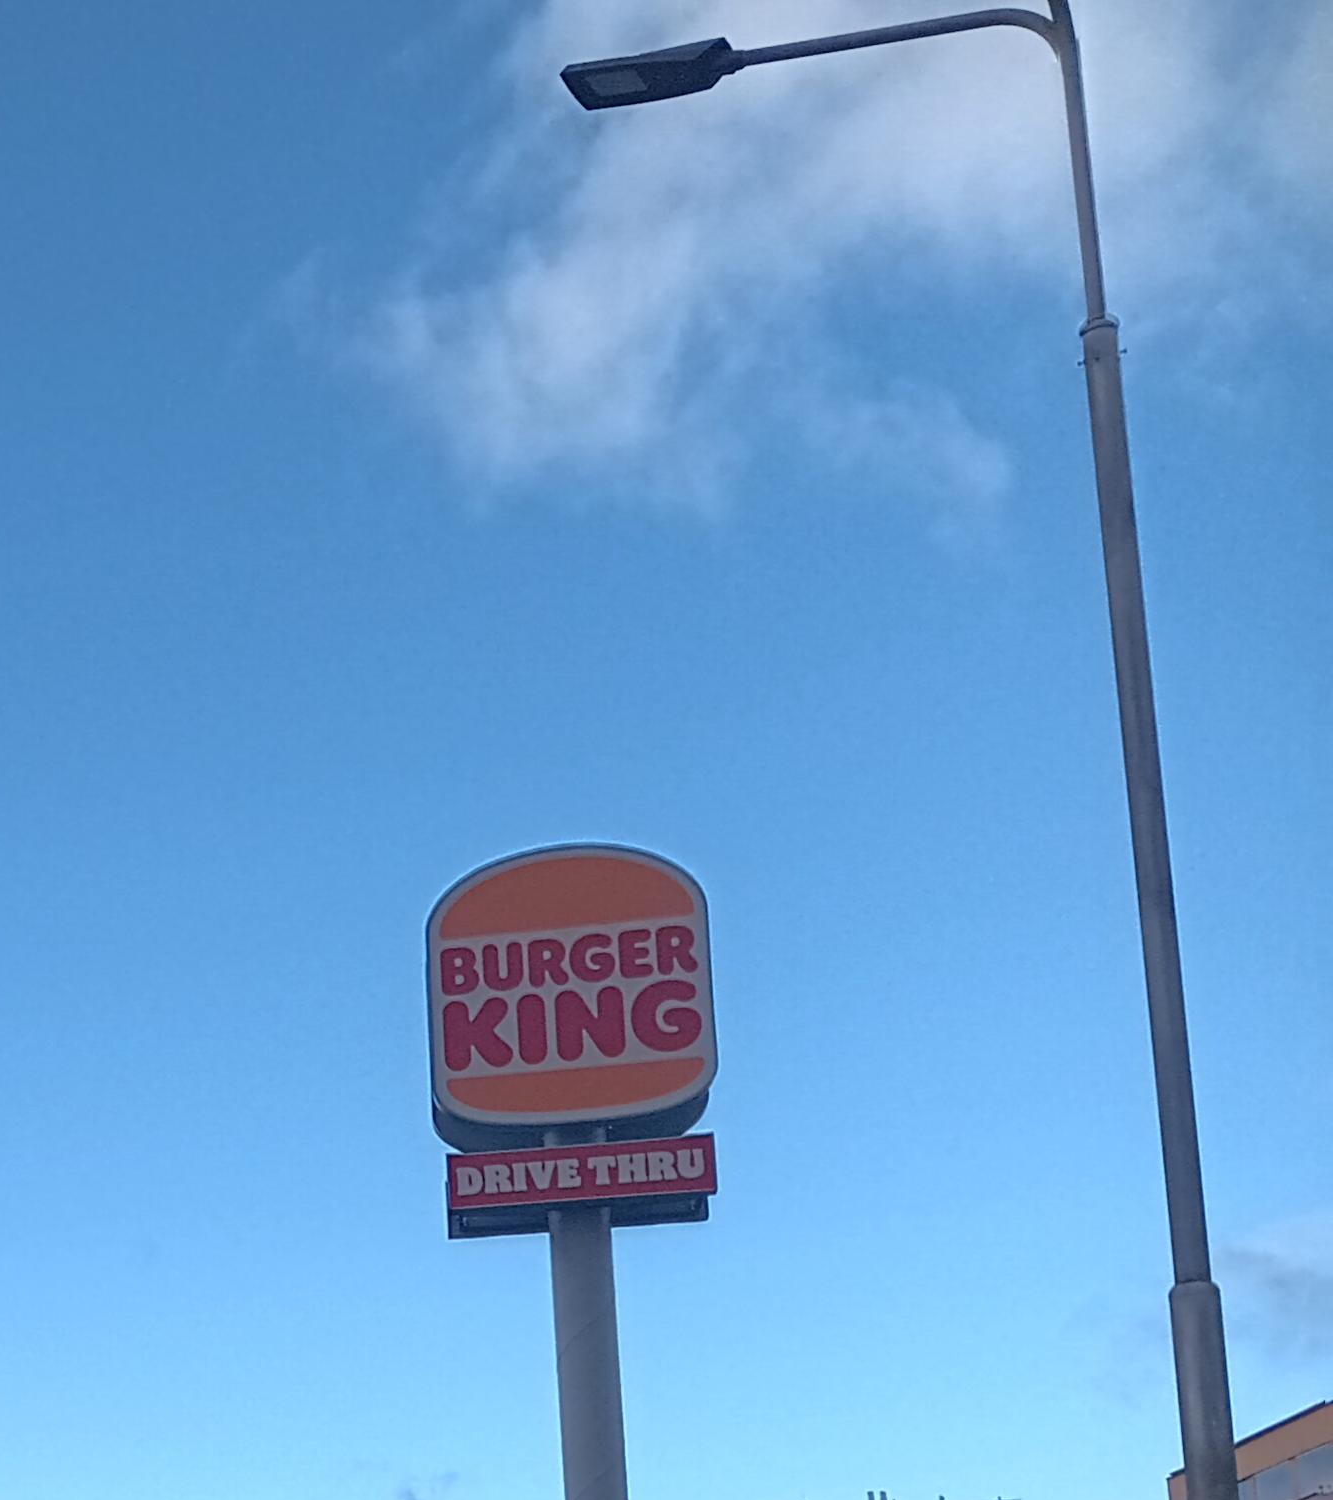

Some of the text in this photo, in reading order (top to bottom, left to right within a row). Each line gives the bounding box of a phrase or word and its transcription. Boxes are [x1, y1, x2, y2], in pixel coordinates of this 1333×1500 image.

[440, 926, 698, 996] BURGER
[443, 980, 702, 1072] KING
[456, 1148, 705, 1197] DRIVE THRU
